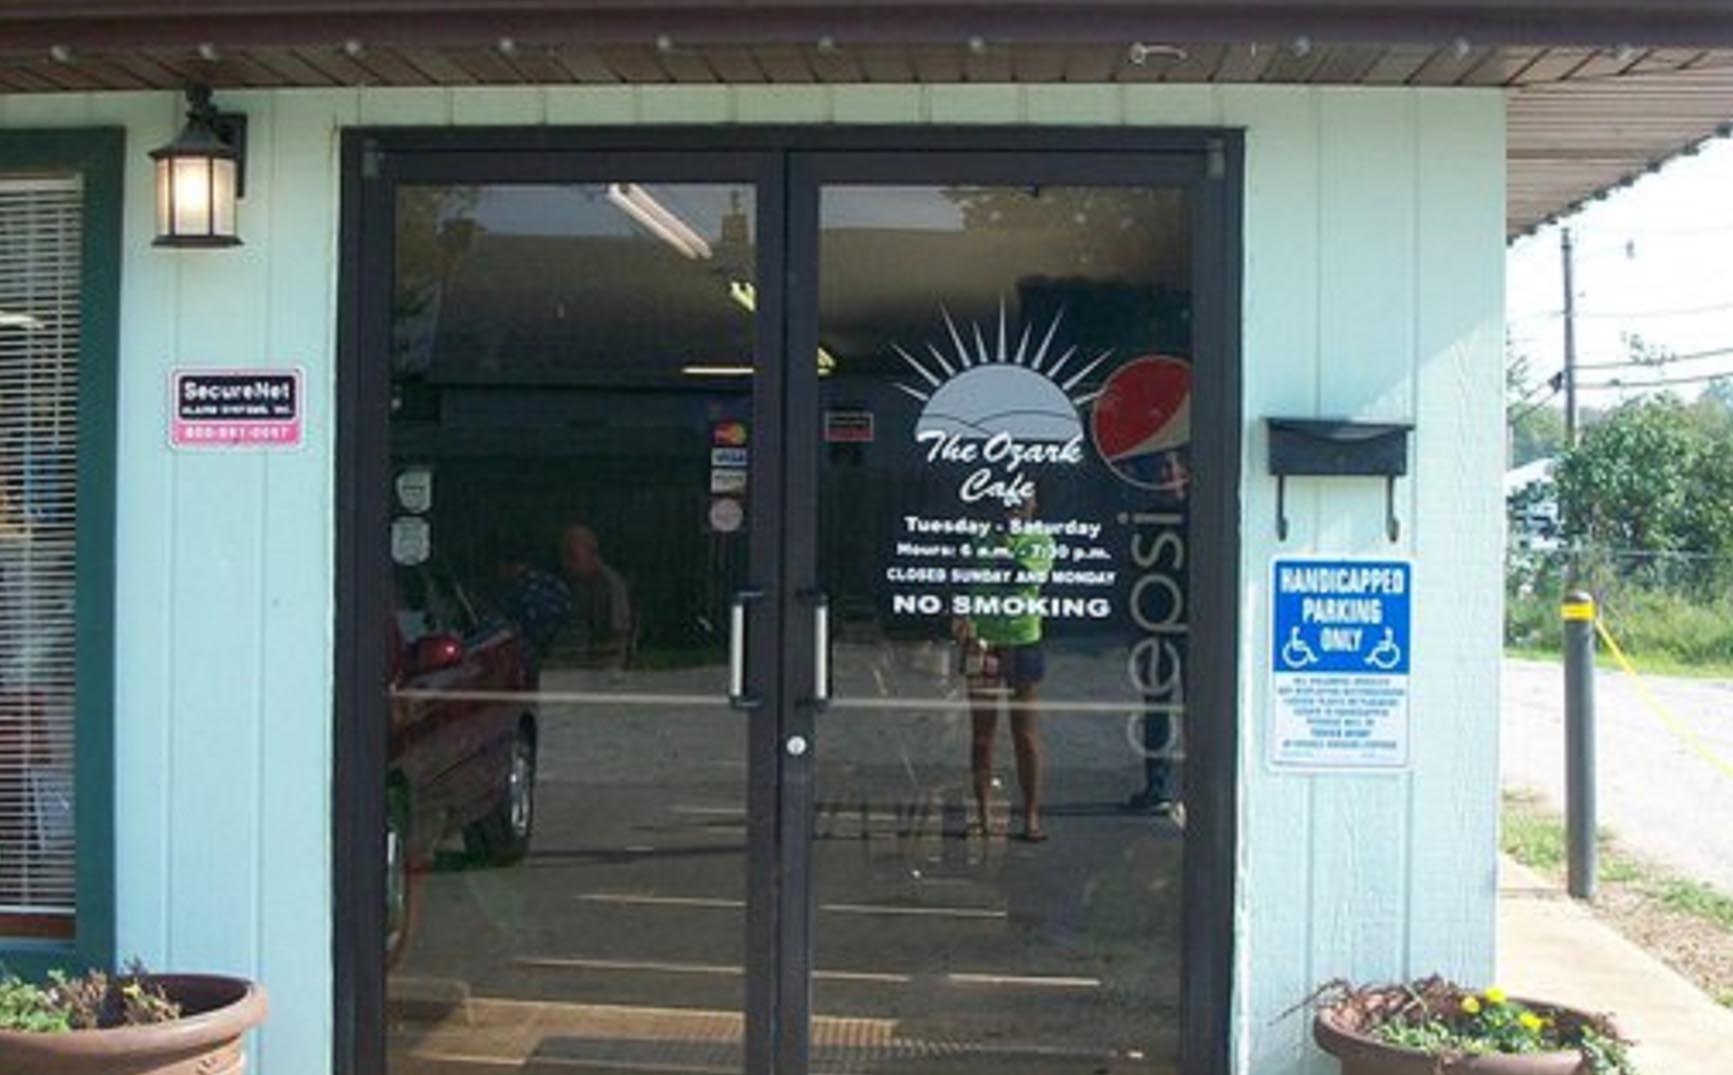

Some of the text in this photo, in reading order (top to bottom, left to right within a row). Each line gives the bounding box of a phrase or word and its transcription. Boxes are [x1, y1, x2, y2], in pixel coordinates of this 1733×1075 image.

[185, 381, 290, 400] SecureNet
[916, 429, 1085, 472] The Ozark
[959, 468, 1036, 507] Cafe
[904, 515, 991, 538] Tuesday
[1009, 517, 1102, 539] Saturday
[896, 542, 956, 557] Hours:
[960, 543, 972, 557] 6
[976, 545, 1015, 559] a.m.
[1072, 547, 1111, 562] p.m.
[886, 567, 1117, 585] CLOSED SUNDAY AND MONDAY
[1280, 568, 1404, 594] HANDICAPPED
[893, 594, 1111, 618] NO SMOKING
[1302, 598, 1382, 624] PARKING
[1117, 512, 1188, 760] pepsi
[1321, 627, 1363, 652] ONLY
